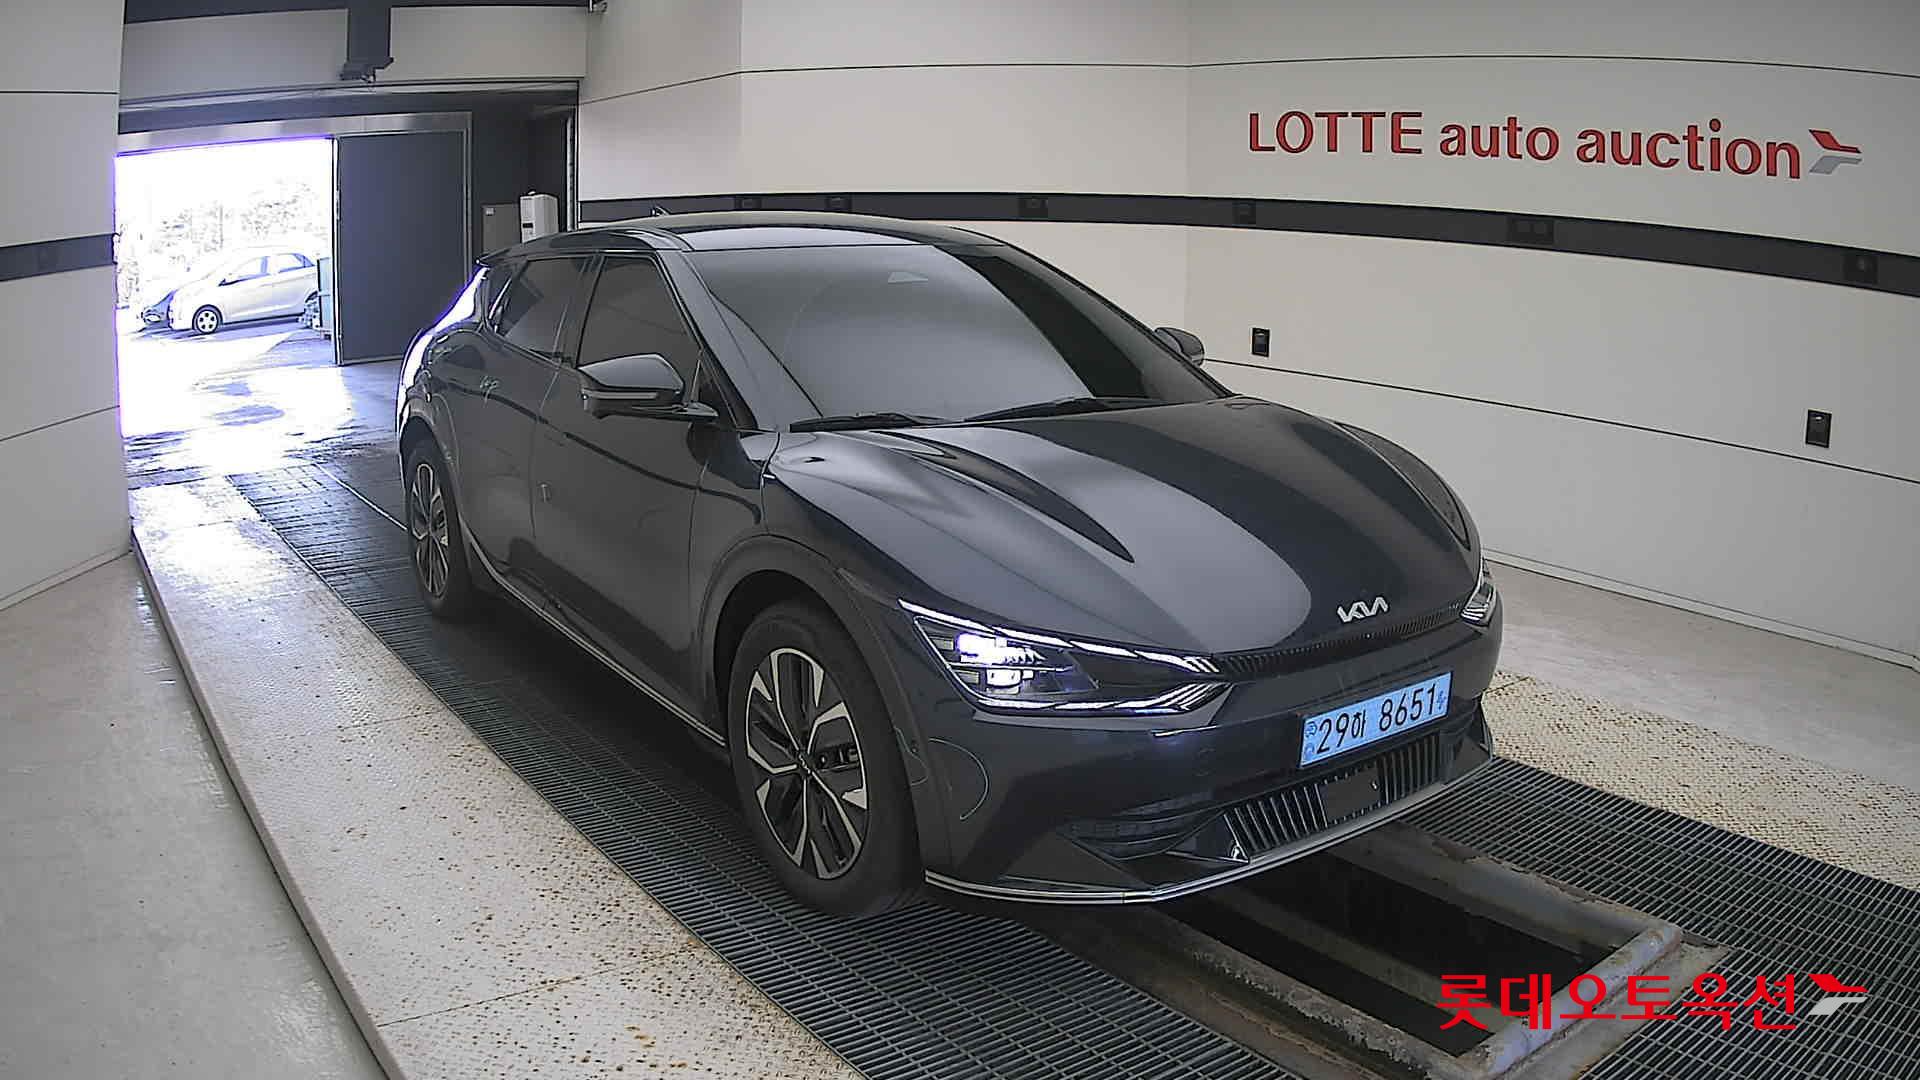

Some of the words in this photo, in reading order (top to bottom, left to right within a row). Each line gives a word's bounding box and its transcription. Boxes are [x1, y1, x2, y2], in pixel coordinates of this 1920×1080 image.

[1249, 111, 1423, 154] LOTTE
[1439, 116, 1560, 160] auto
[1576, 118, 1801, 179] auction
[1316, 708, 1367, 754] 29하
[1379, 683, 1437, 732] 8651
